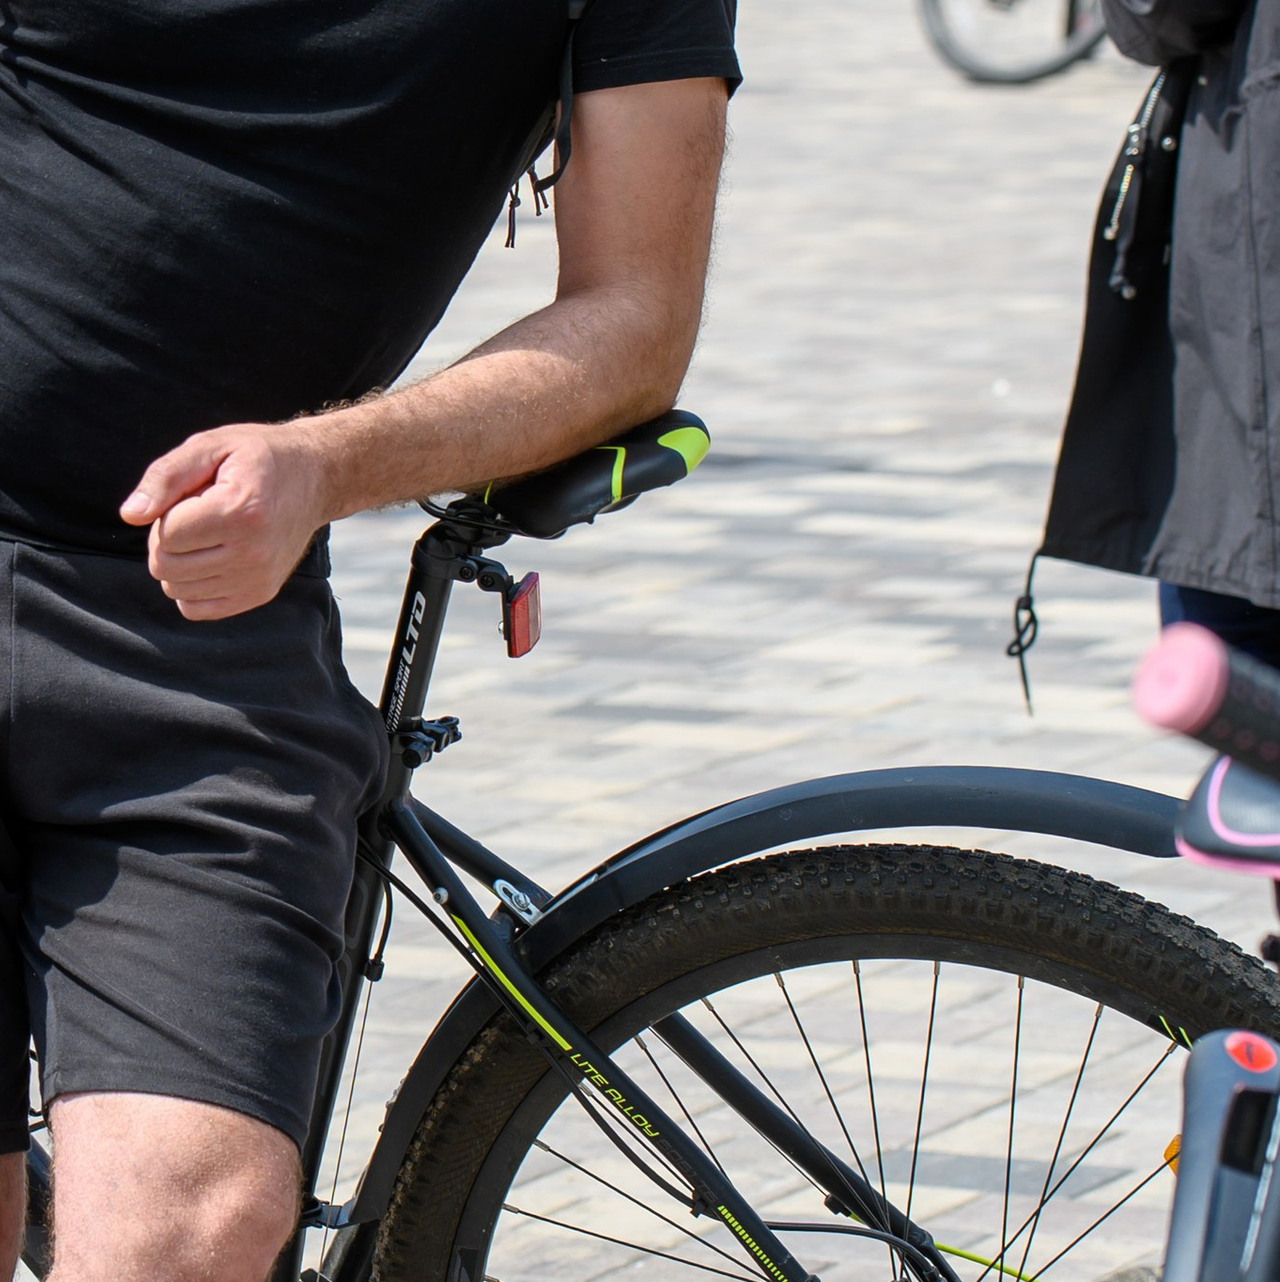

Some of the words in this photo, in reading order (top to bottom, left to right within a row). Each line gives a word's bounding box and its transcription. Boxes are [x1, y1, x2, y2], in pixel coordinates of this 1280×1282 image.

[402, 591, 426, 664] LTD
[570, 1053, 609, 1087] LITE
[605, 1088, 660, 1137] ALLOY
